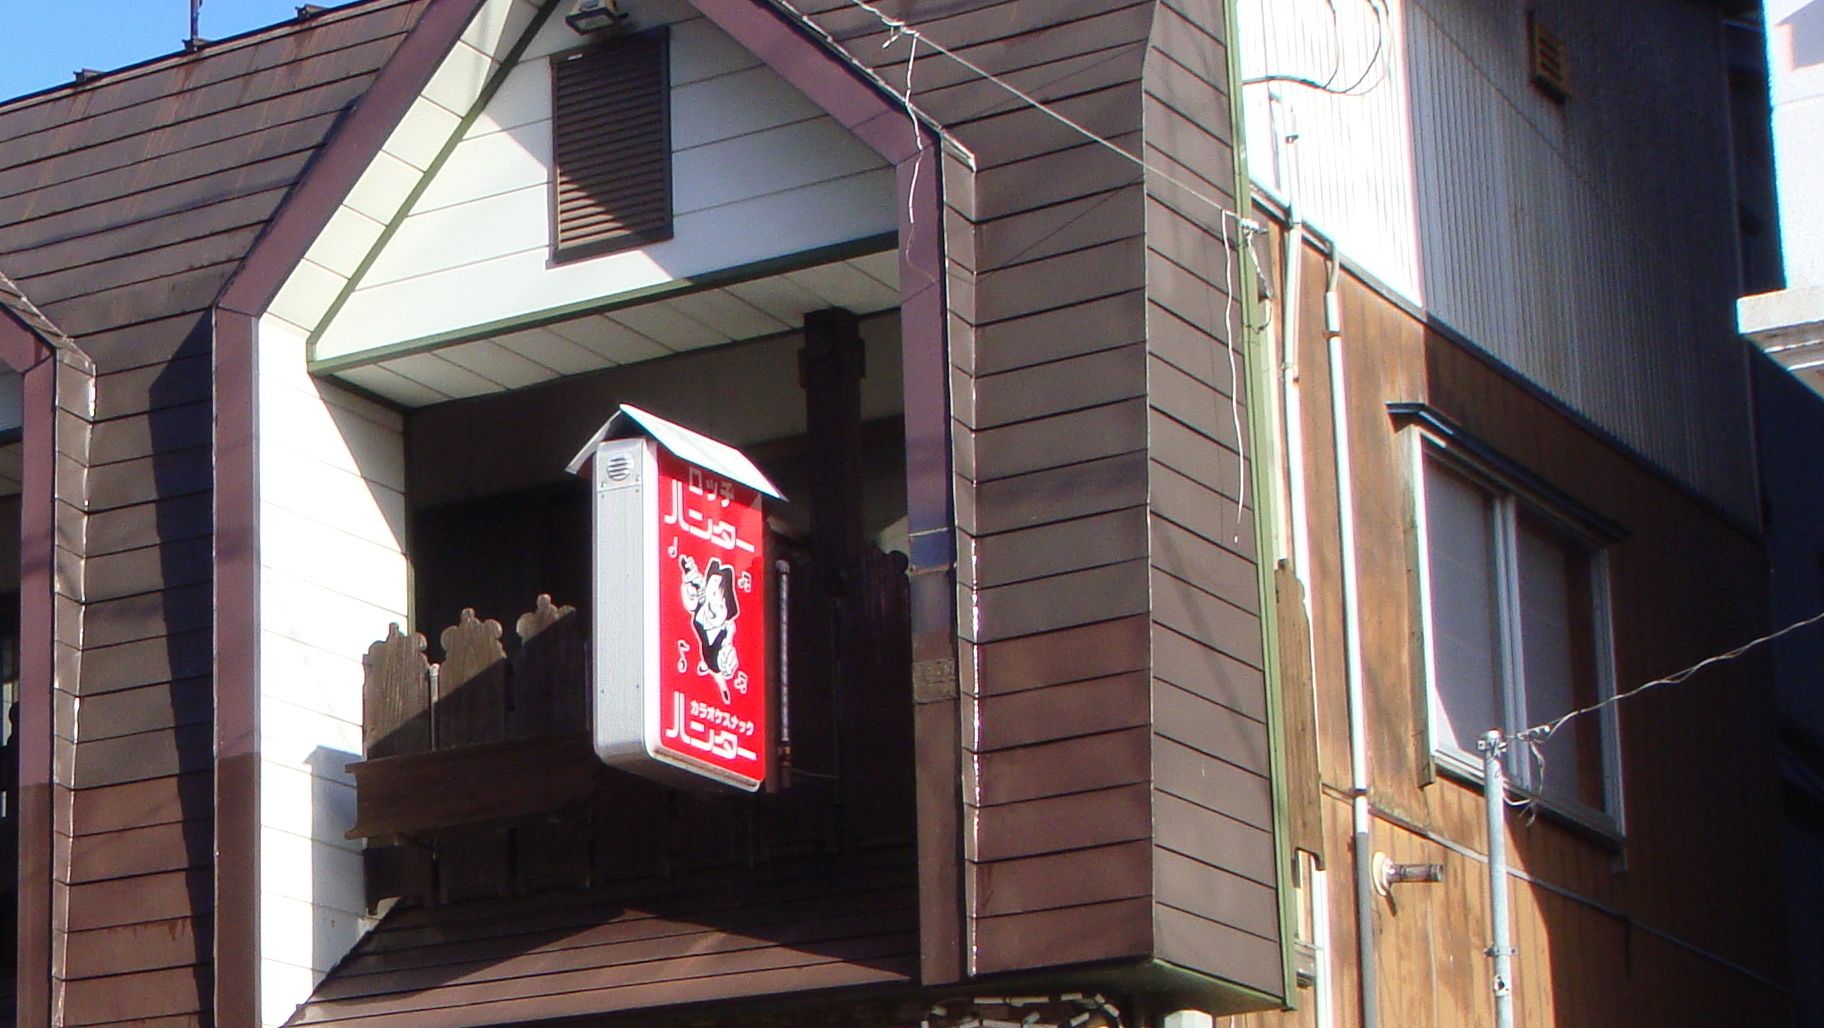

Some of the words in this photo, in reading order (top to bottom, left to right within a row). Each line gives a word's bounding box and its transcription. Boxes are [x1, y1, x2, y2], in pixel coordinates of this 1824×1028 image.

[664, 478, 756, 553] ハンター
[665, 691, 757, 761] ハンター
[689, 699, 755, 736] カラオケスナック
